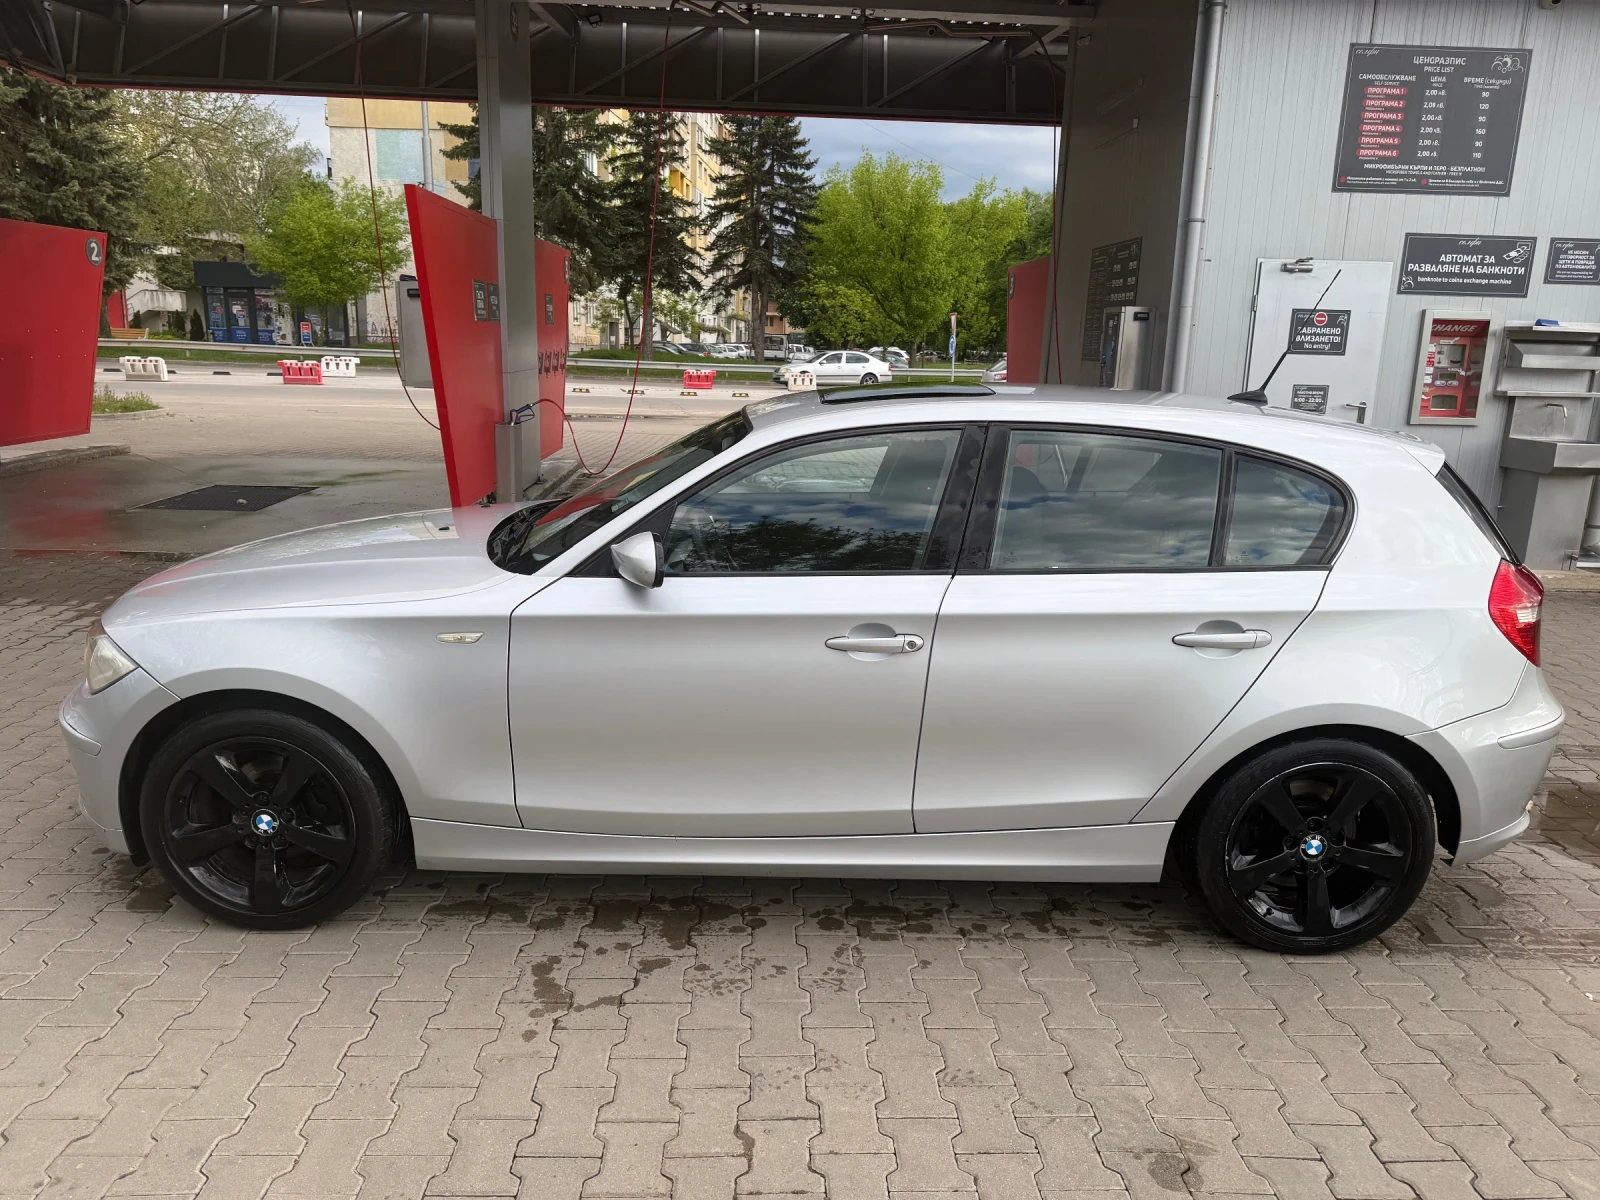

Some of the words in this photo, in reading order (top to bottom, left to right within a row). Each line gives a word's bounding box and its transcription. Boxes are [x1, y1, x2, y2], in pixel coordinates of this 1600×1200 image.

[1413, 56, 1467, 66] ЦЕНОРАЗПИС
[1358, 73, 1417, 82] САМООБСЛУЖВАНЕ
[1367, 87, 1400, 95] ПРОГРАМА
[1364, 112, 1396, 120] ПРОГРАМА
[90, 242, 100, 261] 2
[1439, 254, 1483, 263] АВТОМАТ
[1483, 255, 1495, 264] ЗА
[1407, 263, 1460, 273] РАЗВАЛЯНЕ
[1461, 265, 1475, 274] НА
[1475, 265, 1525, 275] БАНКНОТИ
[1297, 326, 1341, 335] ЗАБРАНЕНО
[1295, 334, 1341, 343] ВЛИЗАНЕТО!
[1313, 343, 1331, 351] entry!
